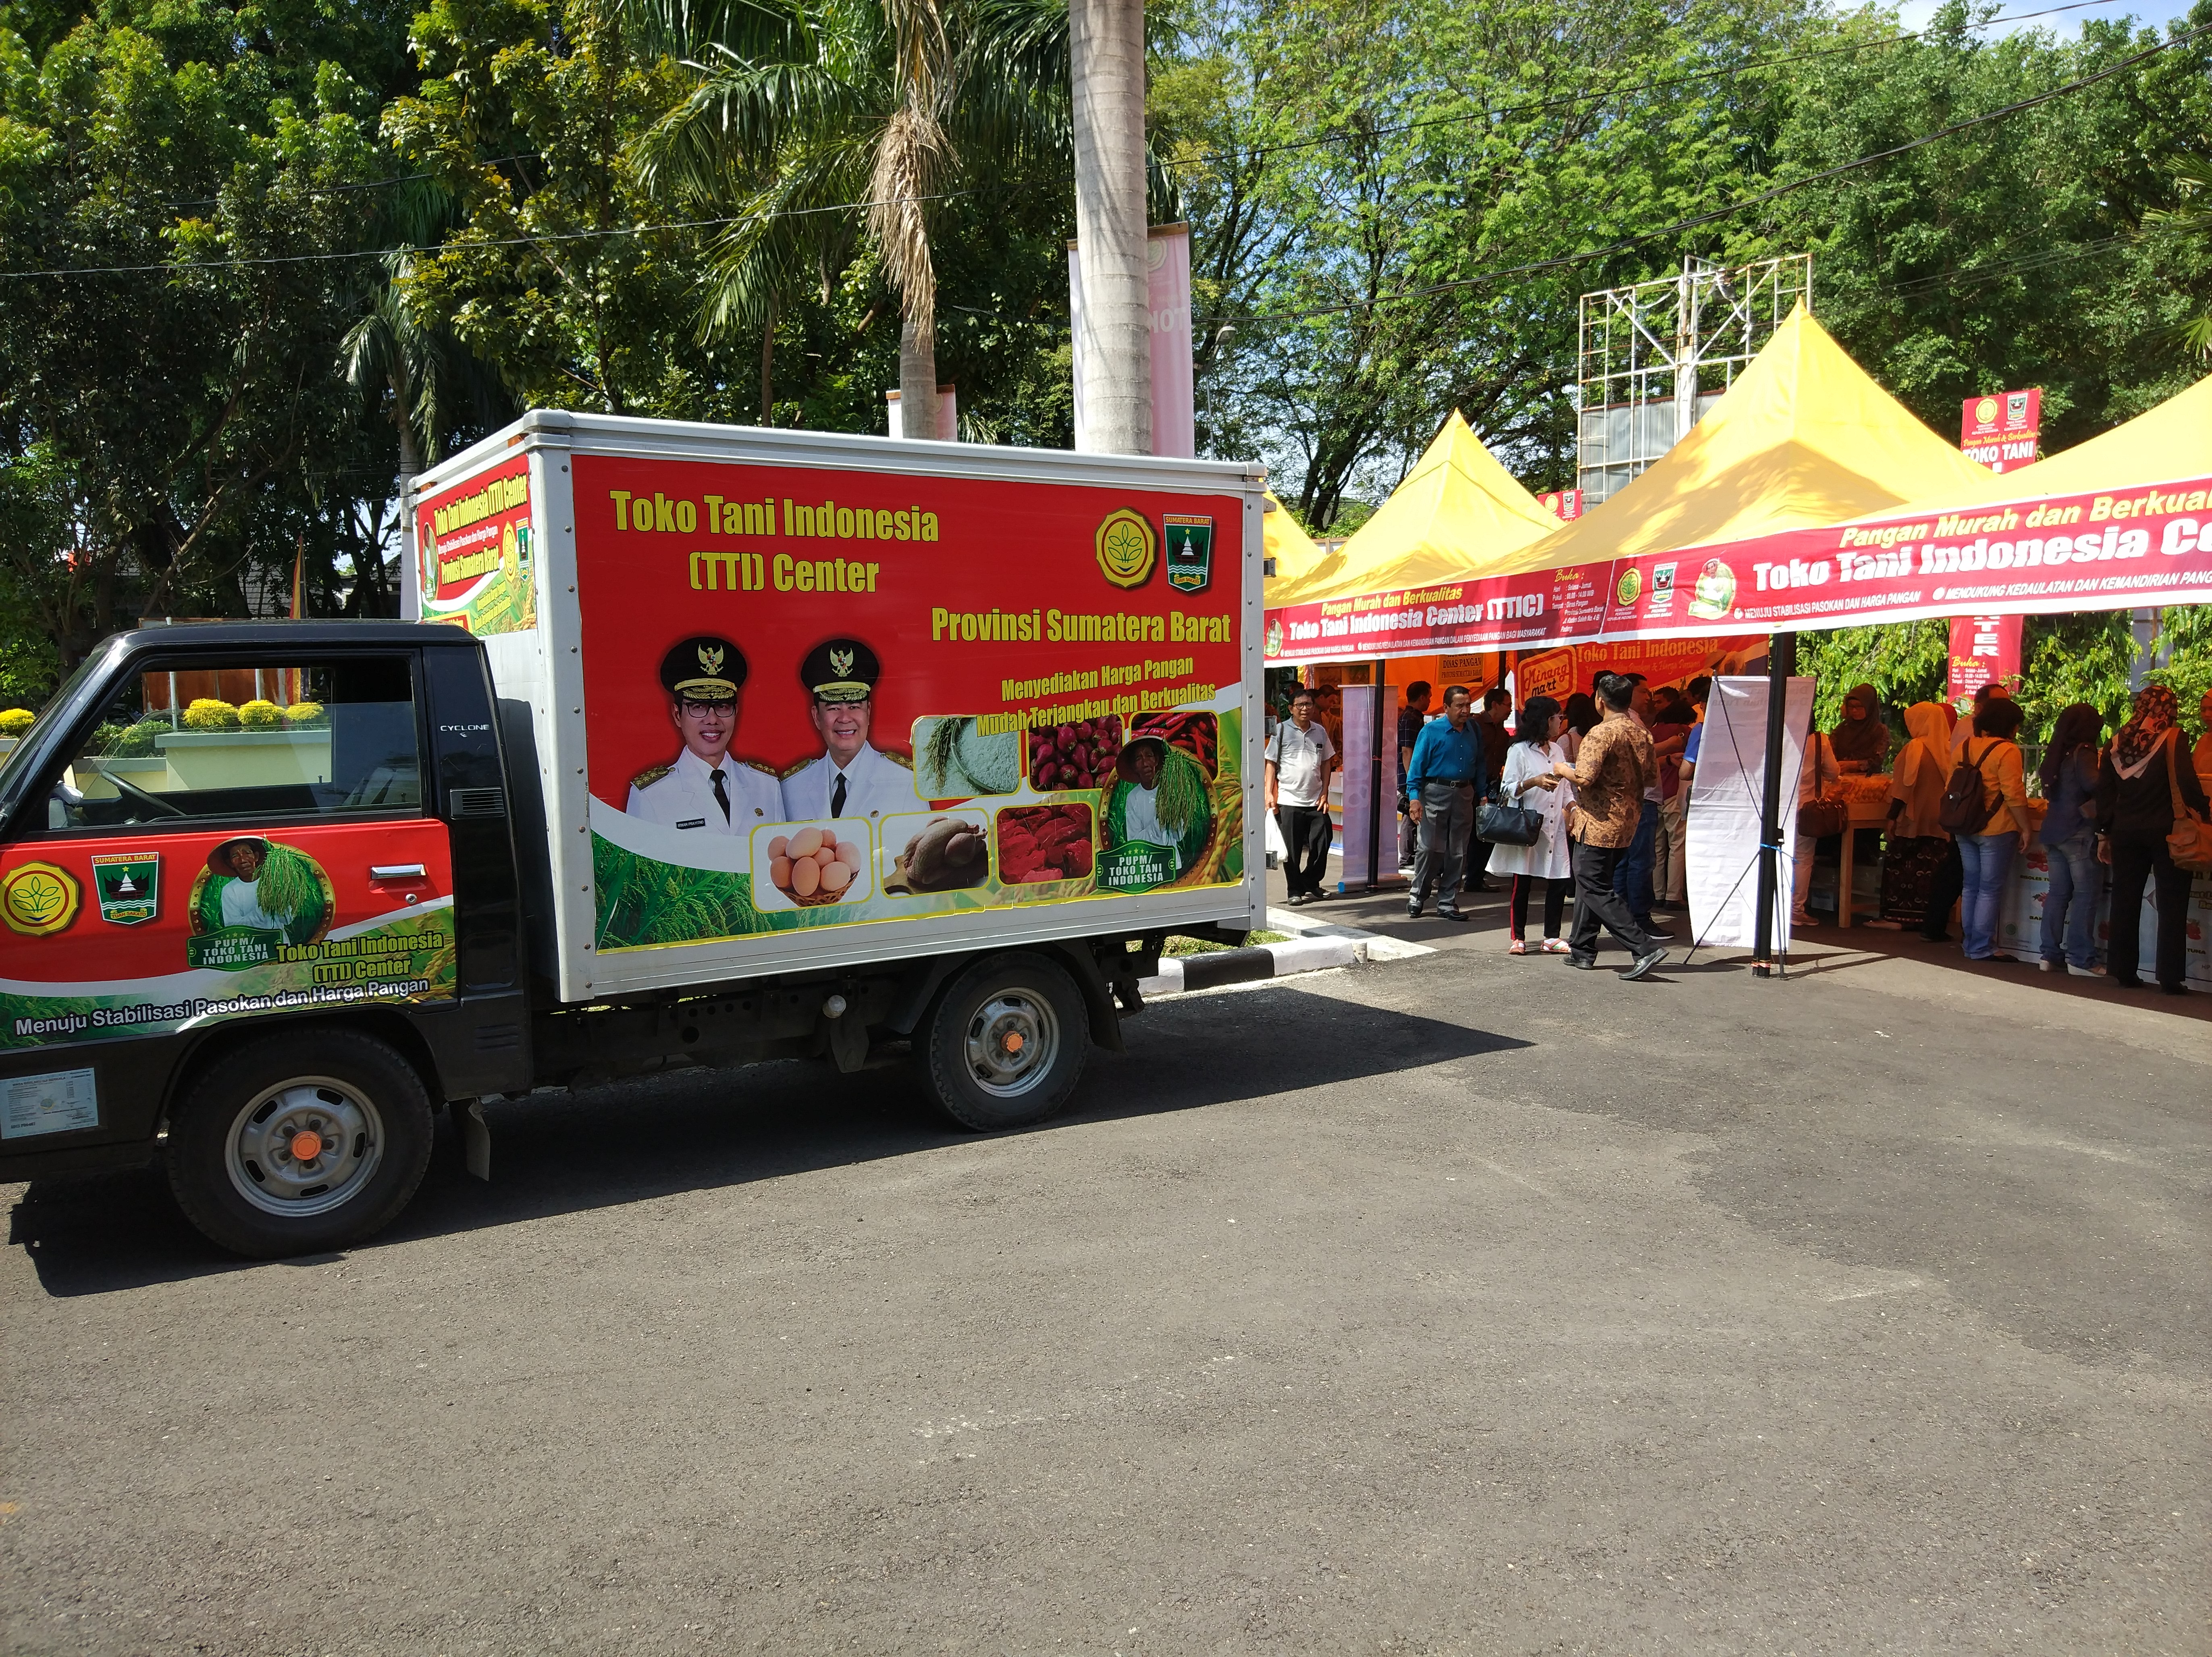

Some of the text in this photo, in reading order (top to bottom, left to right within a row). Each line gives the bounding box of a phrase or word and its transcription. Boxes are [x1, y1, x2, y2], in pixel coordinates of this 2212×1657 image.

[1962, 441, 2033, 463] TOKO TANI
[434, 474, 527, 536] Toko Tani Indonesia (TTI) Center
[609, 490, 939, 542] Toko Tani Indonesia
[477, 529, 486, 542] Harga
[486, 525, 498, 539] Pangan
[1839, 523, 1928, 548] Pangan
[1933, 508, 2019, 538] Murah
[2025, 505, 2081, 528] dan
[441, 544, 500, 584] Provinsi Sumatera Barat
[1753, 525, 2149, 592] Toko Tani Indonesia
[688, 552, 879, 593] (TTI) Center
[1554, 568, 1580, 582] Buka
[1321, 587, 1462, 617] Pangan Murah dan Berkualitas
[1745, 606, 1772, 619] MENUJU
[1773, 603, 1811, 617] STABILISASI
[1811, 601, 1844, 613] PASOKAN
[1844, 597, 1861, 610] DAN
[1861, 594, 1887, 608] HARGA
[1887, 591, 1921, 604] PANGAN
[1944, 586, 2005, 600] MENDUKUNG
[2006, 579, 2073, 596] KEDAULATAN
[2075, 577, 2100, 590] DAN
[2101, 571, 2180, 590] KEMANDIRIAN
[931, 607, 1231, 643] Provinsi Sumatera Barat
[1289, 593, 1544, 640] Toko Tani Indonesia Center (TTIC)
[1410, 637, 1435, 647] KEMANDIRIAN
[1434, 635, 1449, 645] PANGAN
[1450, 634, 1463, 644] DALAM
[1464, 632, 1488, 643] PENYEDIAAN
[1488, 631, 1506, 641] PANGAN
[1505, 630, 1517, 640] BAGI
[1517, 627, 1547, 639] MASYARAKAT
[1576, 638, 1719, 662] Toko Tani Indonesia
[1443, 657, 1482, 669] DINAS PANGAN
[1952, 656, 1979, 667] Buka
[1002, 656, 1193, 702] Menyediakan Harga Pangan
[1524, 663, 1569, 692] Minang
[1532, 677, 1556, 696] mart
[977, 683, 1216, 737] Mudah Terjangkau dan Berkualitas
[1109, 863, 1162, 877] TOKO TANI
[1119, 854, 1153, 866] PUPM/
[1108, 874, 1164, 886] INDONESIA
[203, 943, 267, 957] TOKO TANI
[214, 936, 255, 948] PUPM/
[276, 932, 443, 963] Toko Tani Indonesia
[202, 951, 269, 965] INDONESIA
[313, 959, 411, 982] (TTI) Center
[16, 979, 428, 1036] Menuju Stabilisasi Pasokan dan Harga Pangan
